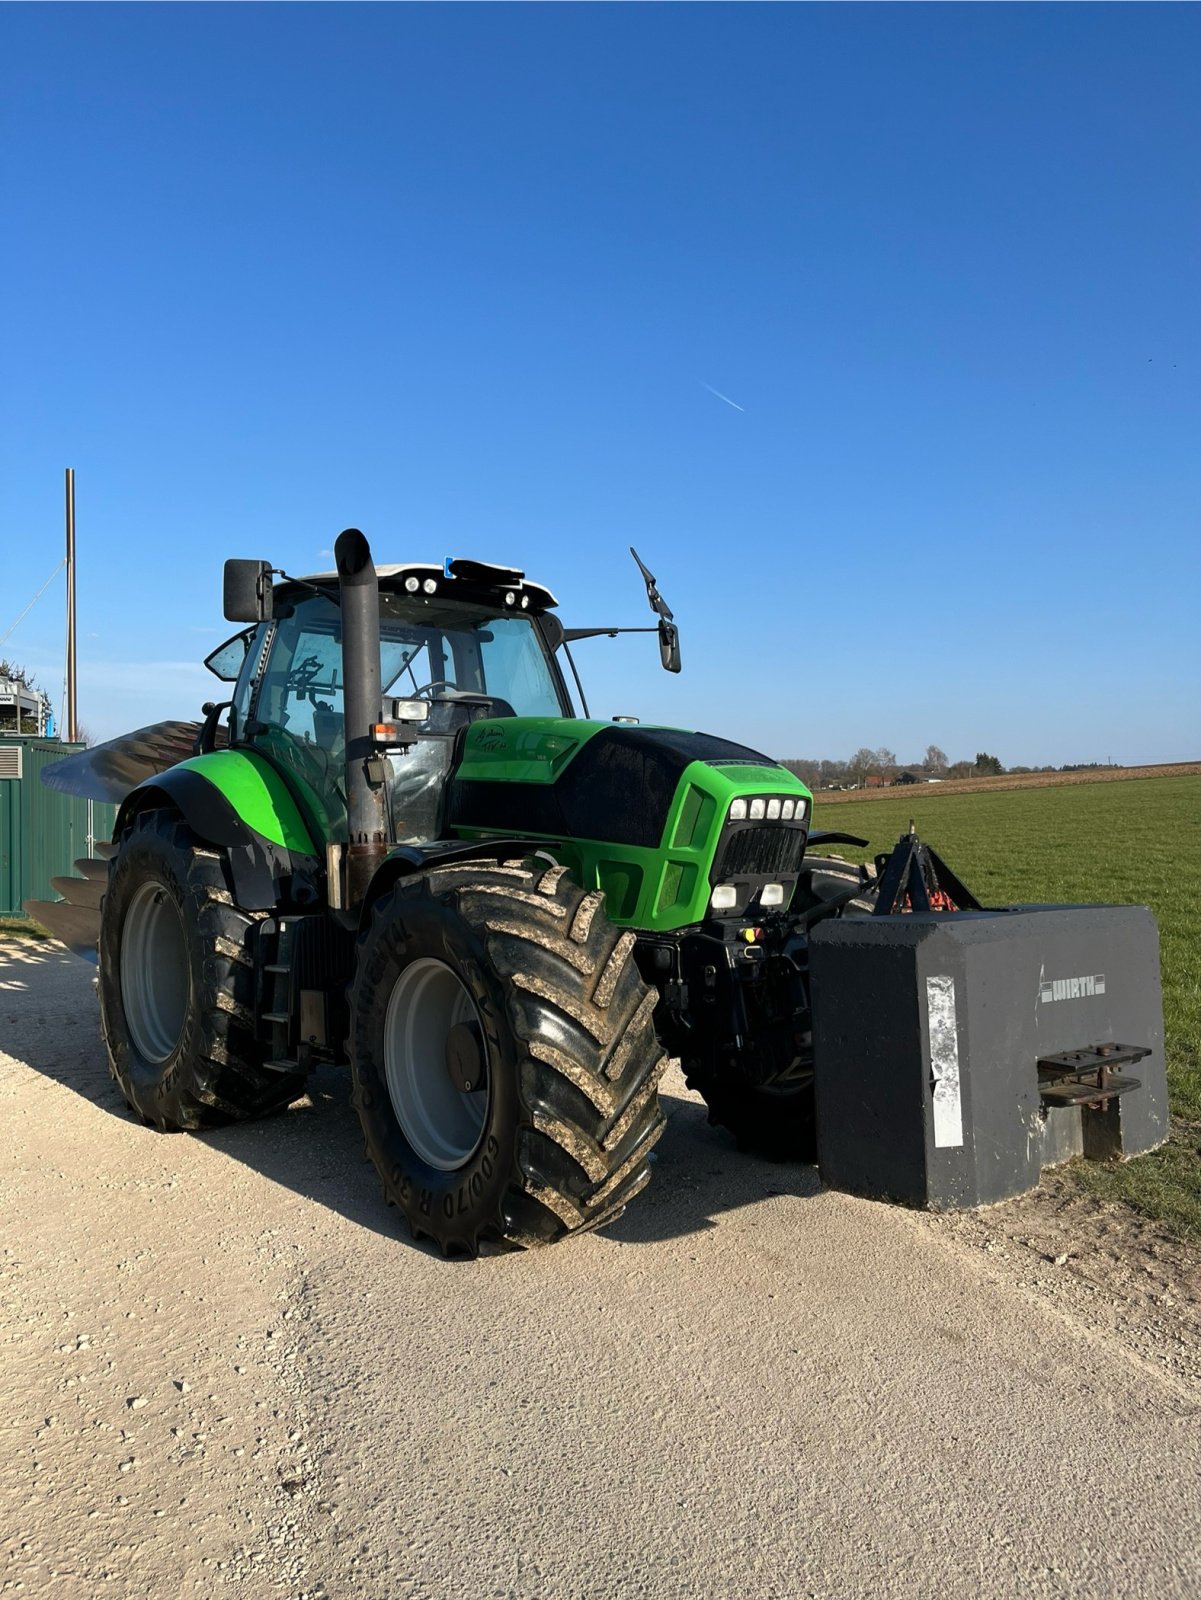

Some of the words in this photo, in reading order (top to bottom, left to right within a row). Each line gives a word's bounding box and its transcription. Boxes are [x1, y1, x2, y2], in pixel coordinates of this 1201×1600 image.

[391, 1163, 412, 1199] 30
[443, 1135, 499, 1219] 600/70
[420, 1188, 433, 1216] R
